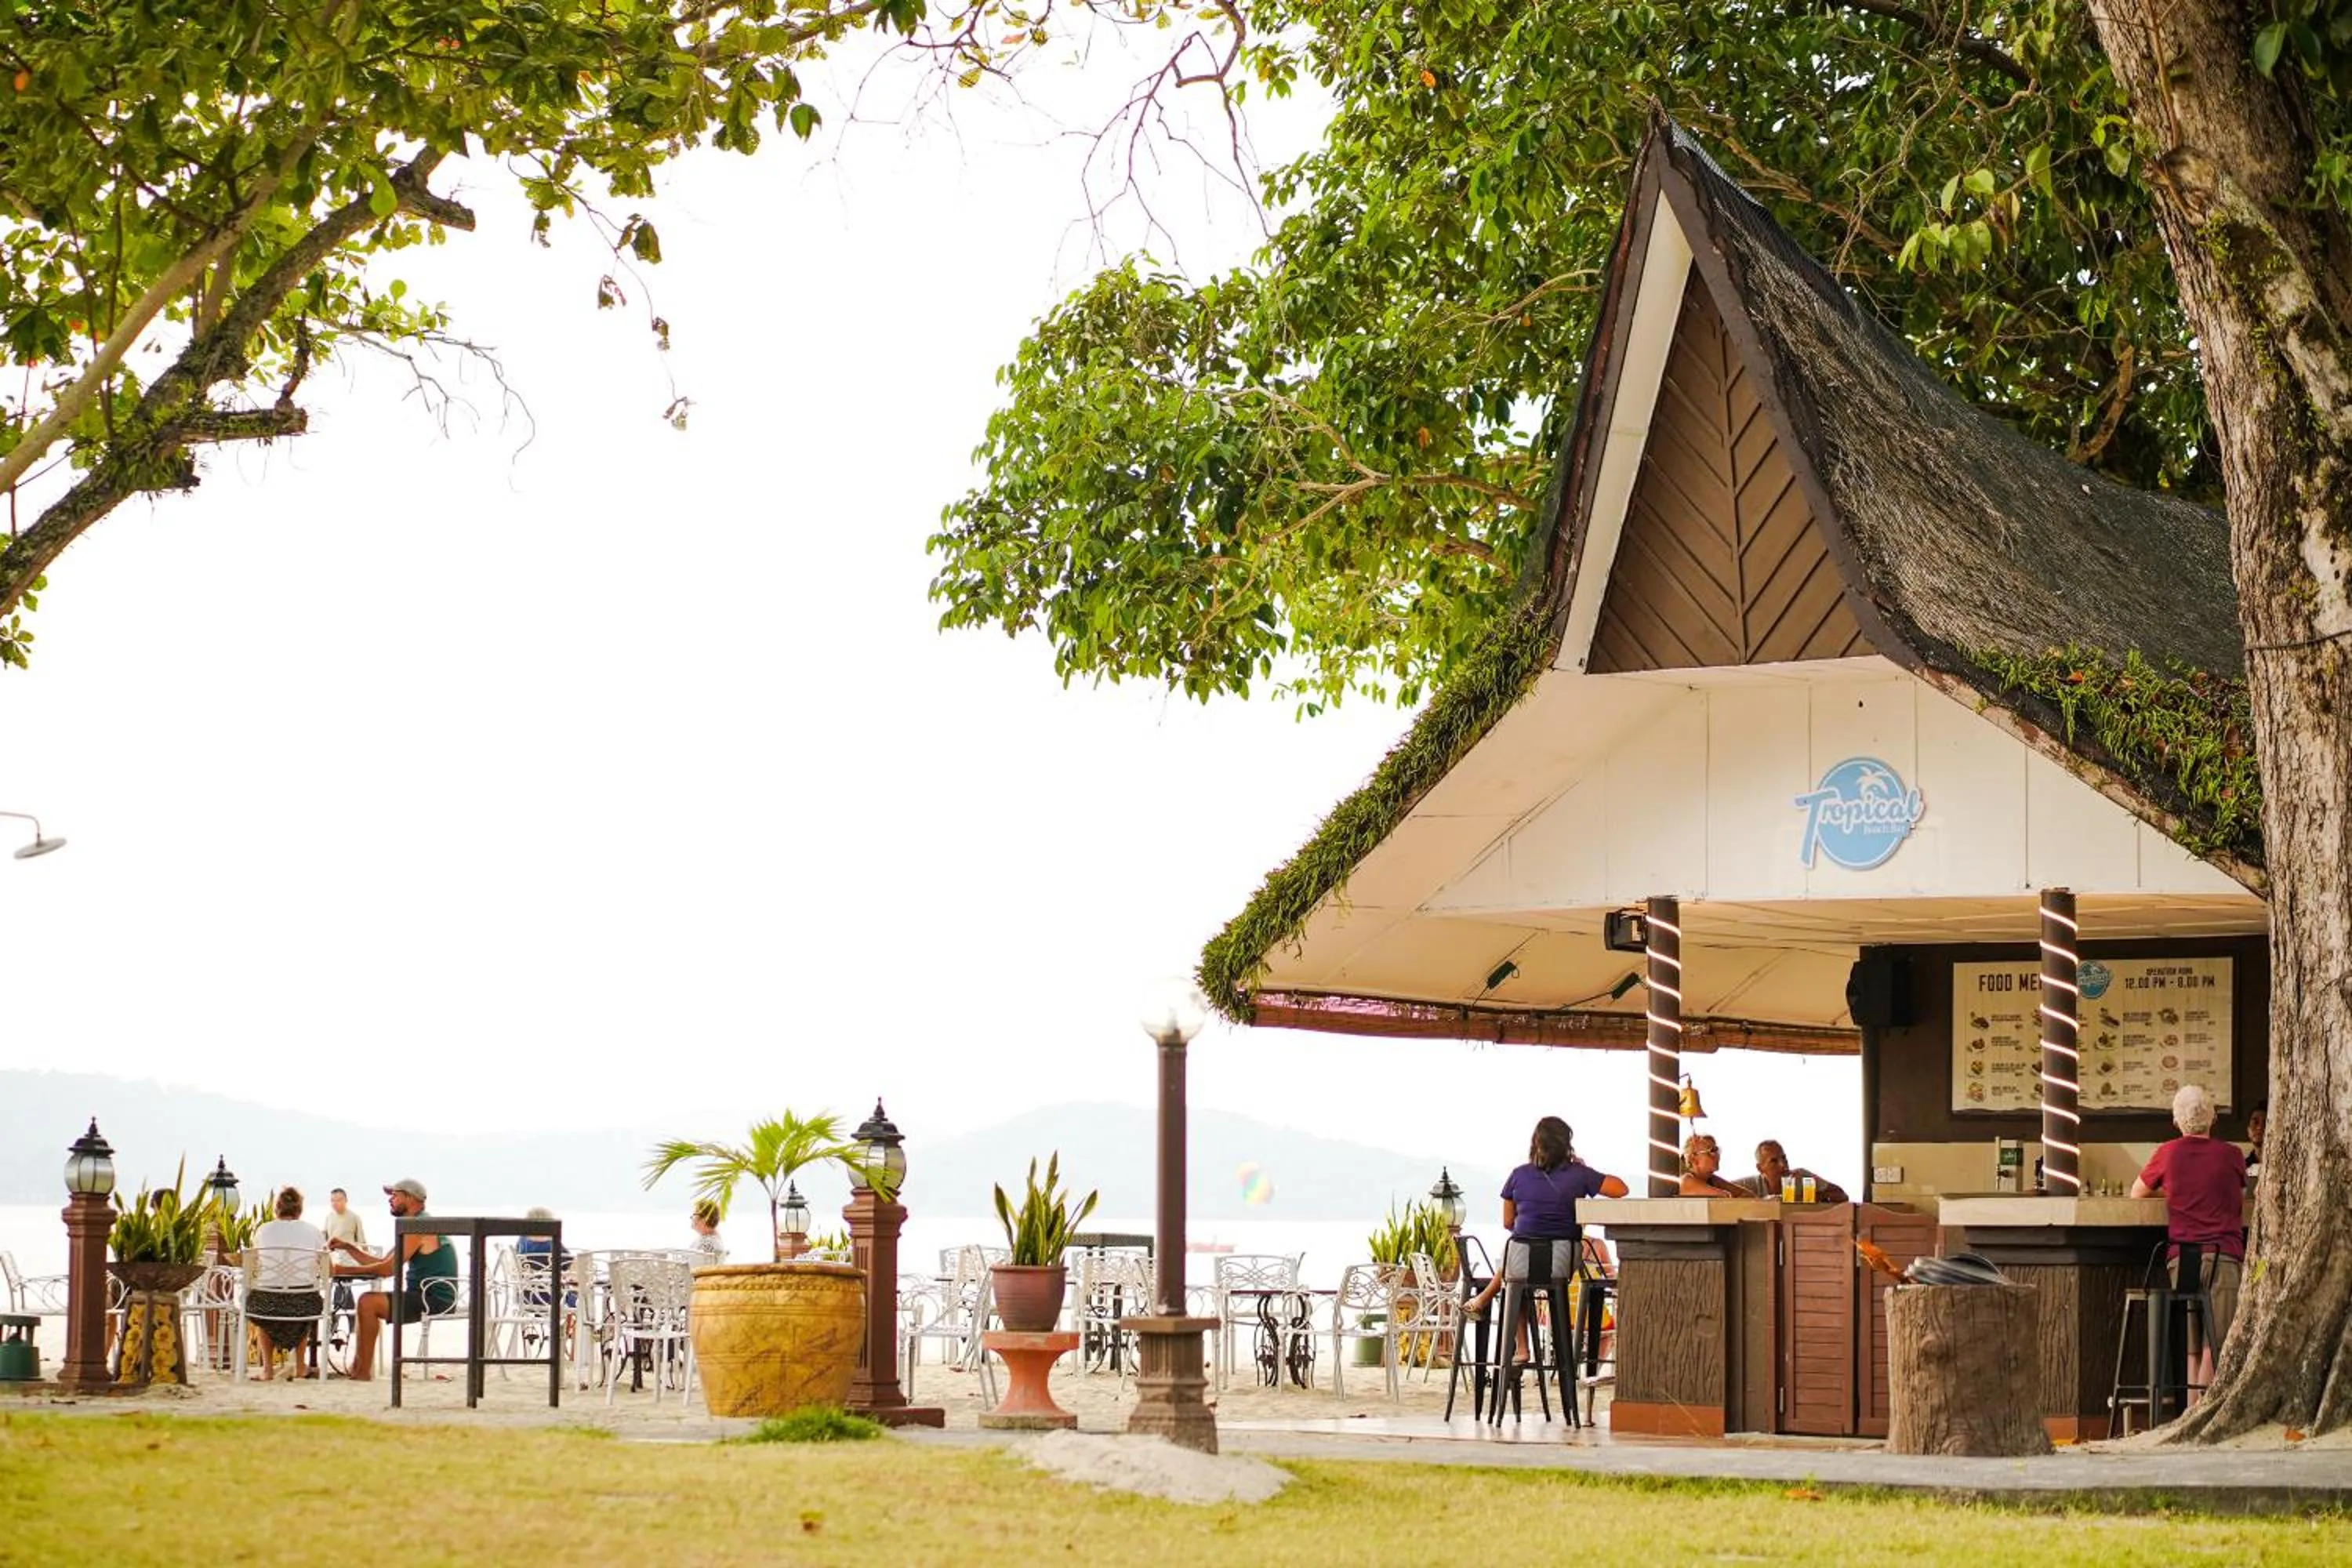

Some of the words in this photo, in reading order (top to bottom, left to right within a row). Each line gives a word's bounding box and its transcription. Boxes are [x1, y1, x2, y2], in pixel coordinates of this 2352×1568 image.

[1795, 786, 1925, 868] Tropical
[1979, 974, 2013, 992] FOOD
[2125, 978, 2150, 989] 12.00
[2152, 976, 2166, 989] PM
[2177, 975, 2198, 989] 8.00
[2202, 975, 2215, 988] PM
